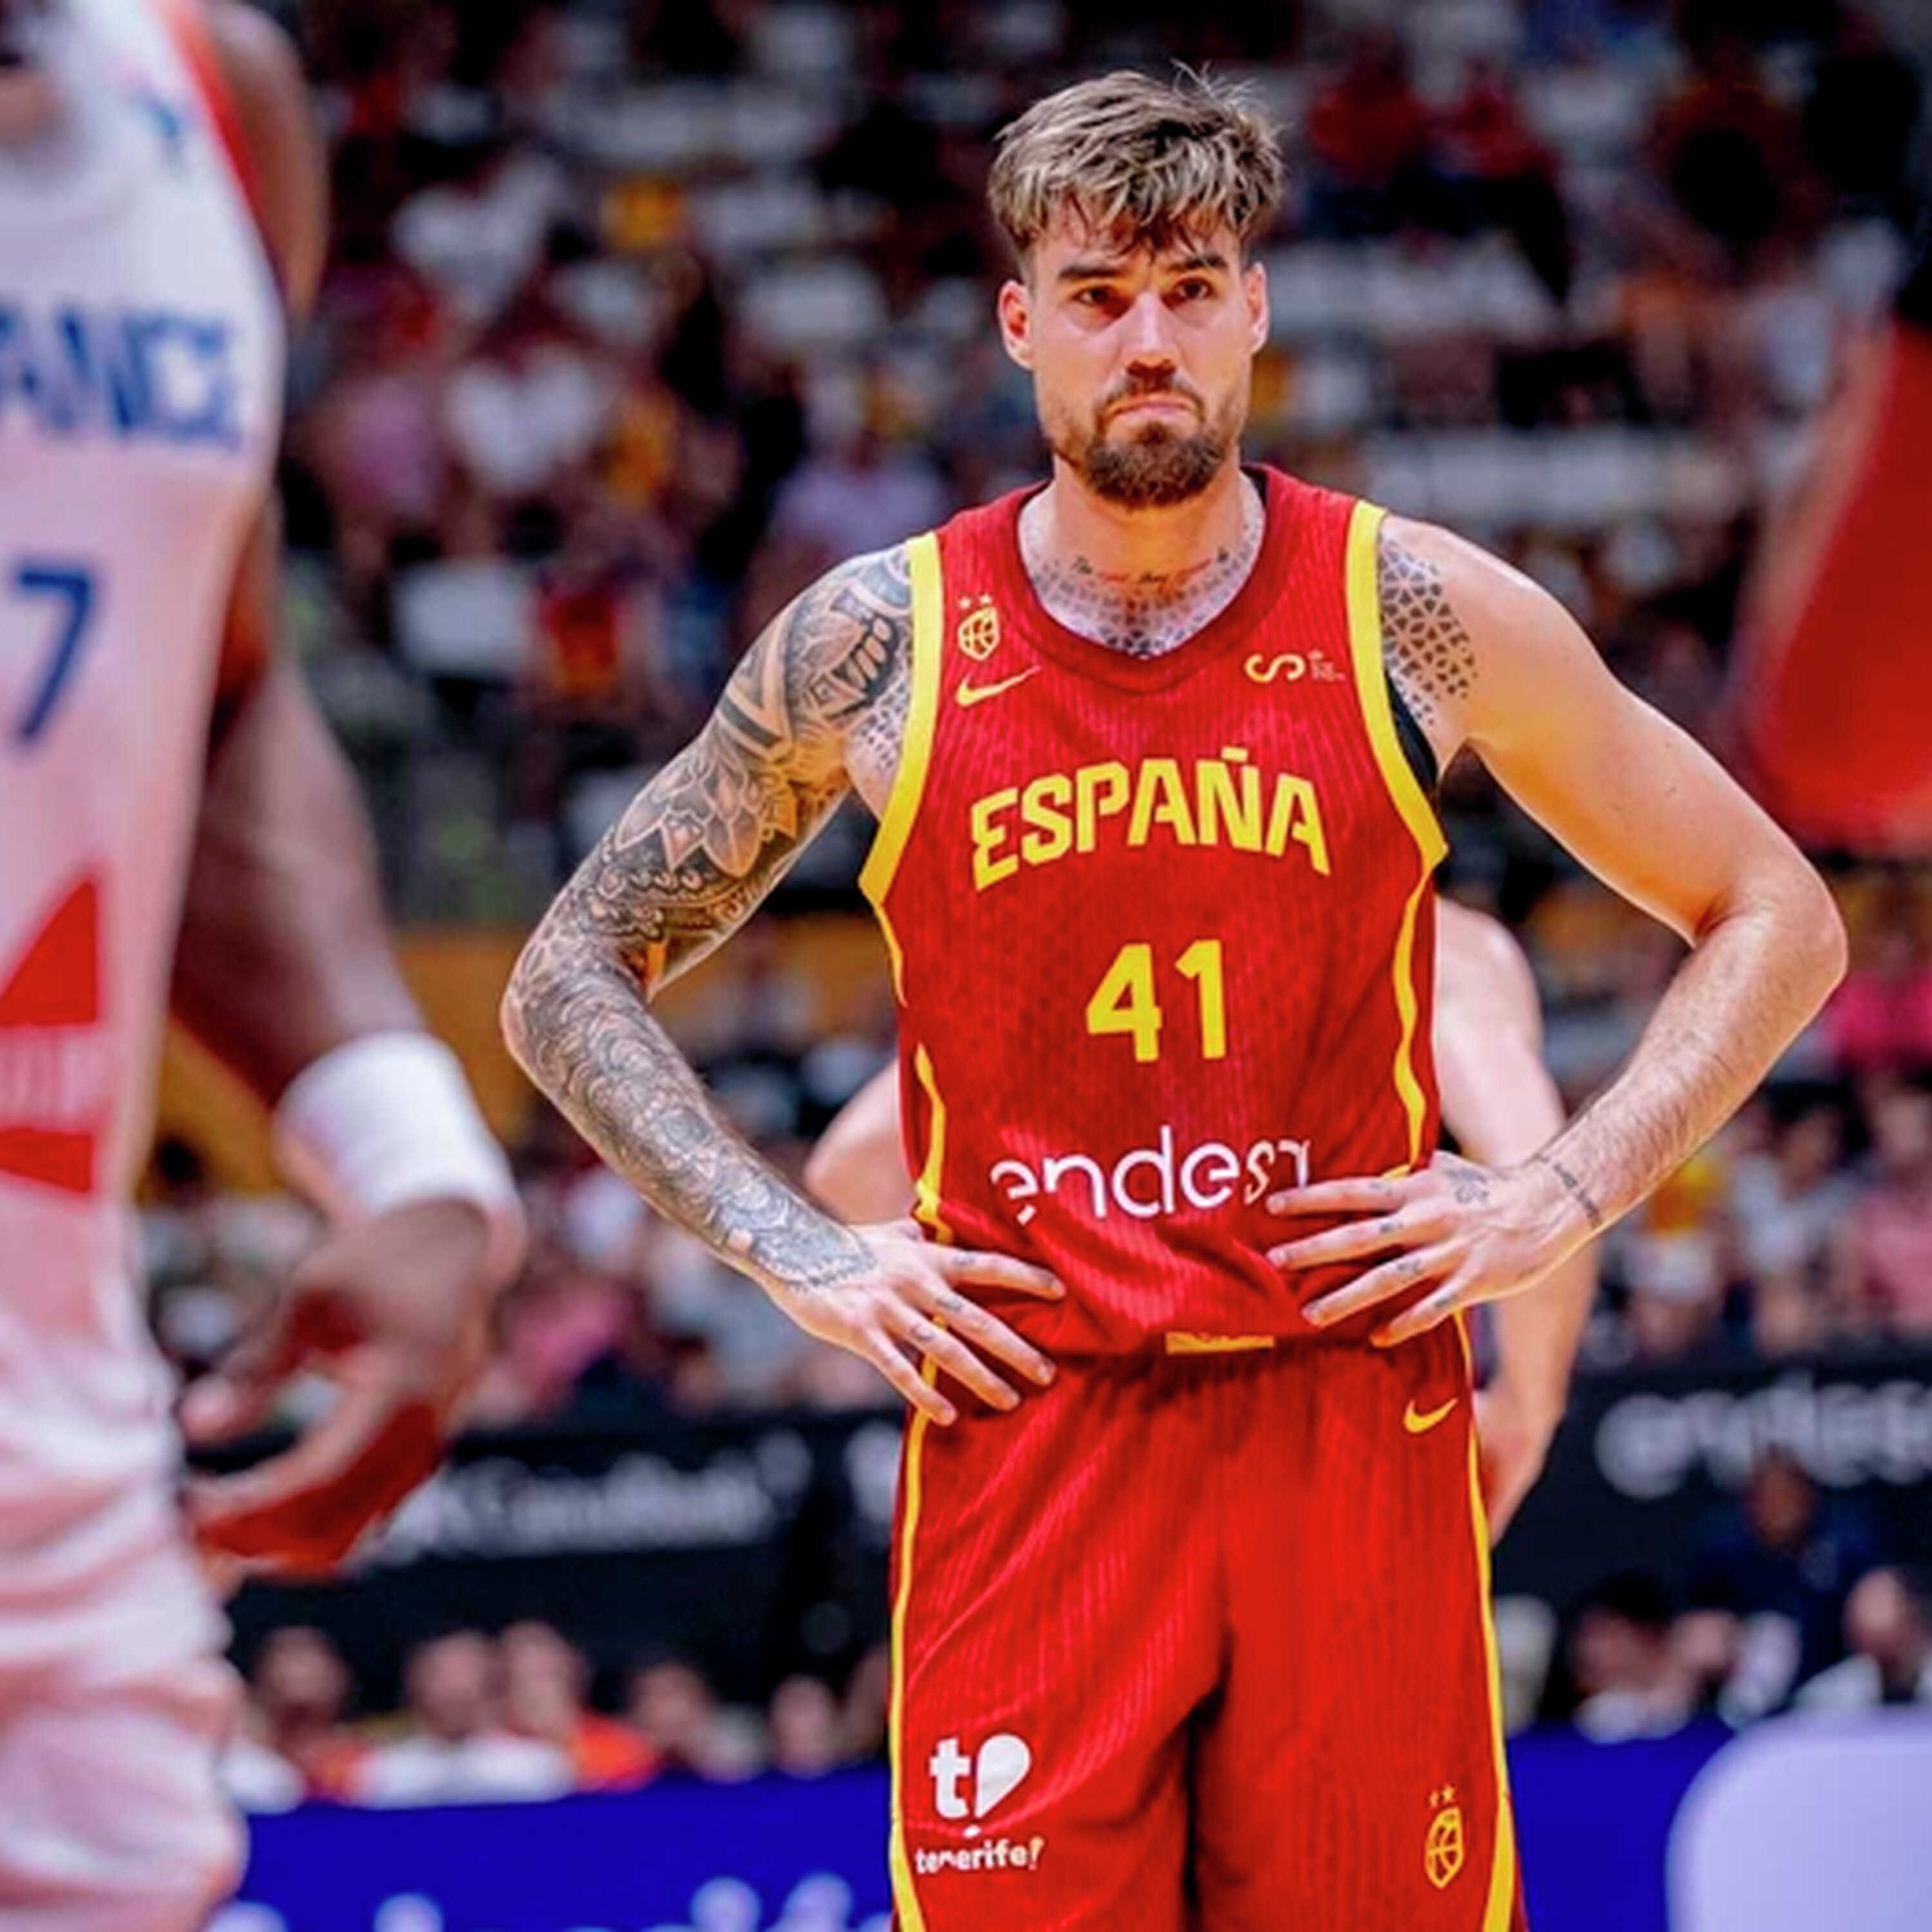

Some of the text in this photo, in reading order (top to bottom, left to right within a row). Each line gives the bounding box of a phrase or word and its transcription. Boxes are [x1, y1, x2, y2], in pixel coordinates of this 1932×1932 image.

[13, 558, 99, 746] 7
[971, 746, 1331, 891] ESPAÑA
[1086, 939, 1226, 1063] 41
